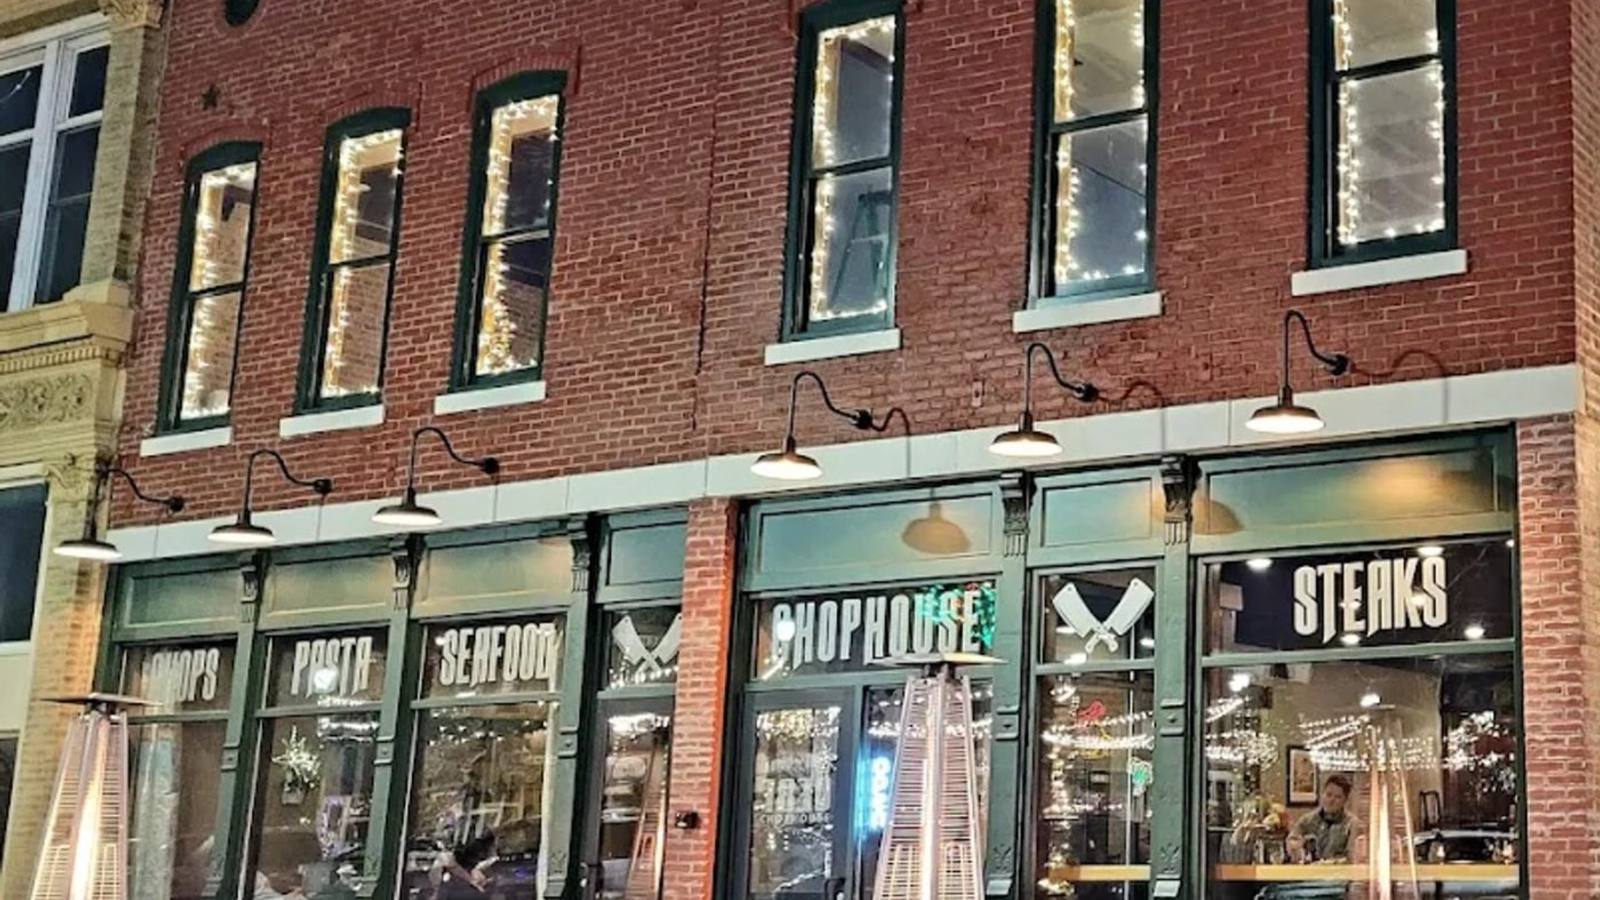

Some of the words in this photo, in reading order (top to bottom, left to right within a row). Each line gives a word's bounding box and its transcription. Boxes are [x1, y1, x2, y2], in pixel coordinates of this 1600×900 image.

[773, 588, 980, 668] CHOPHOUSE
[1294, 556, 1447, 644] STEAKS
[291, 636, 372, 698] PASTA
[440, 623, 556, 687] SEAFOOD
